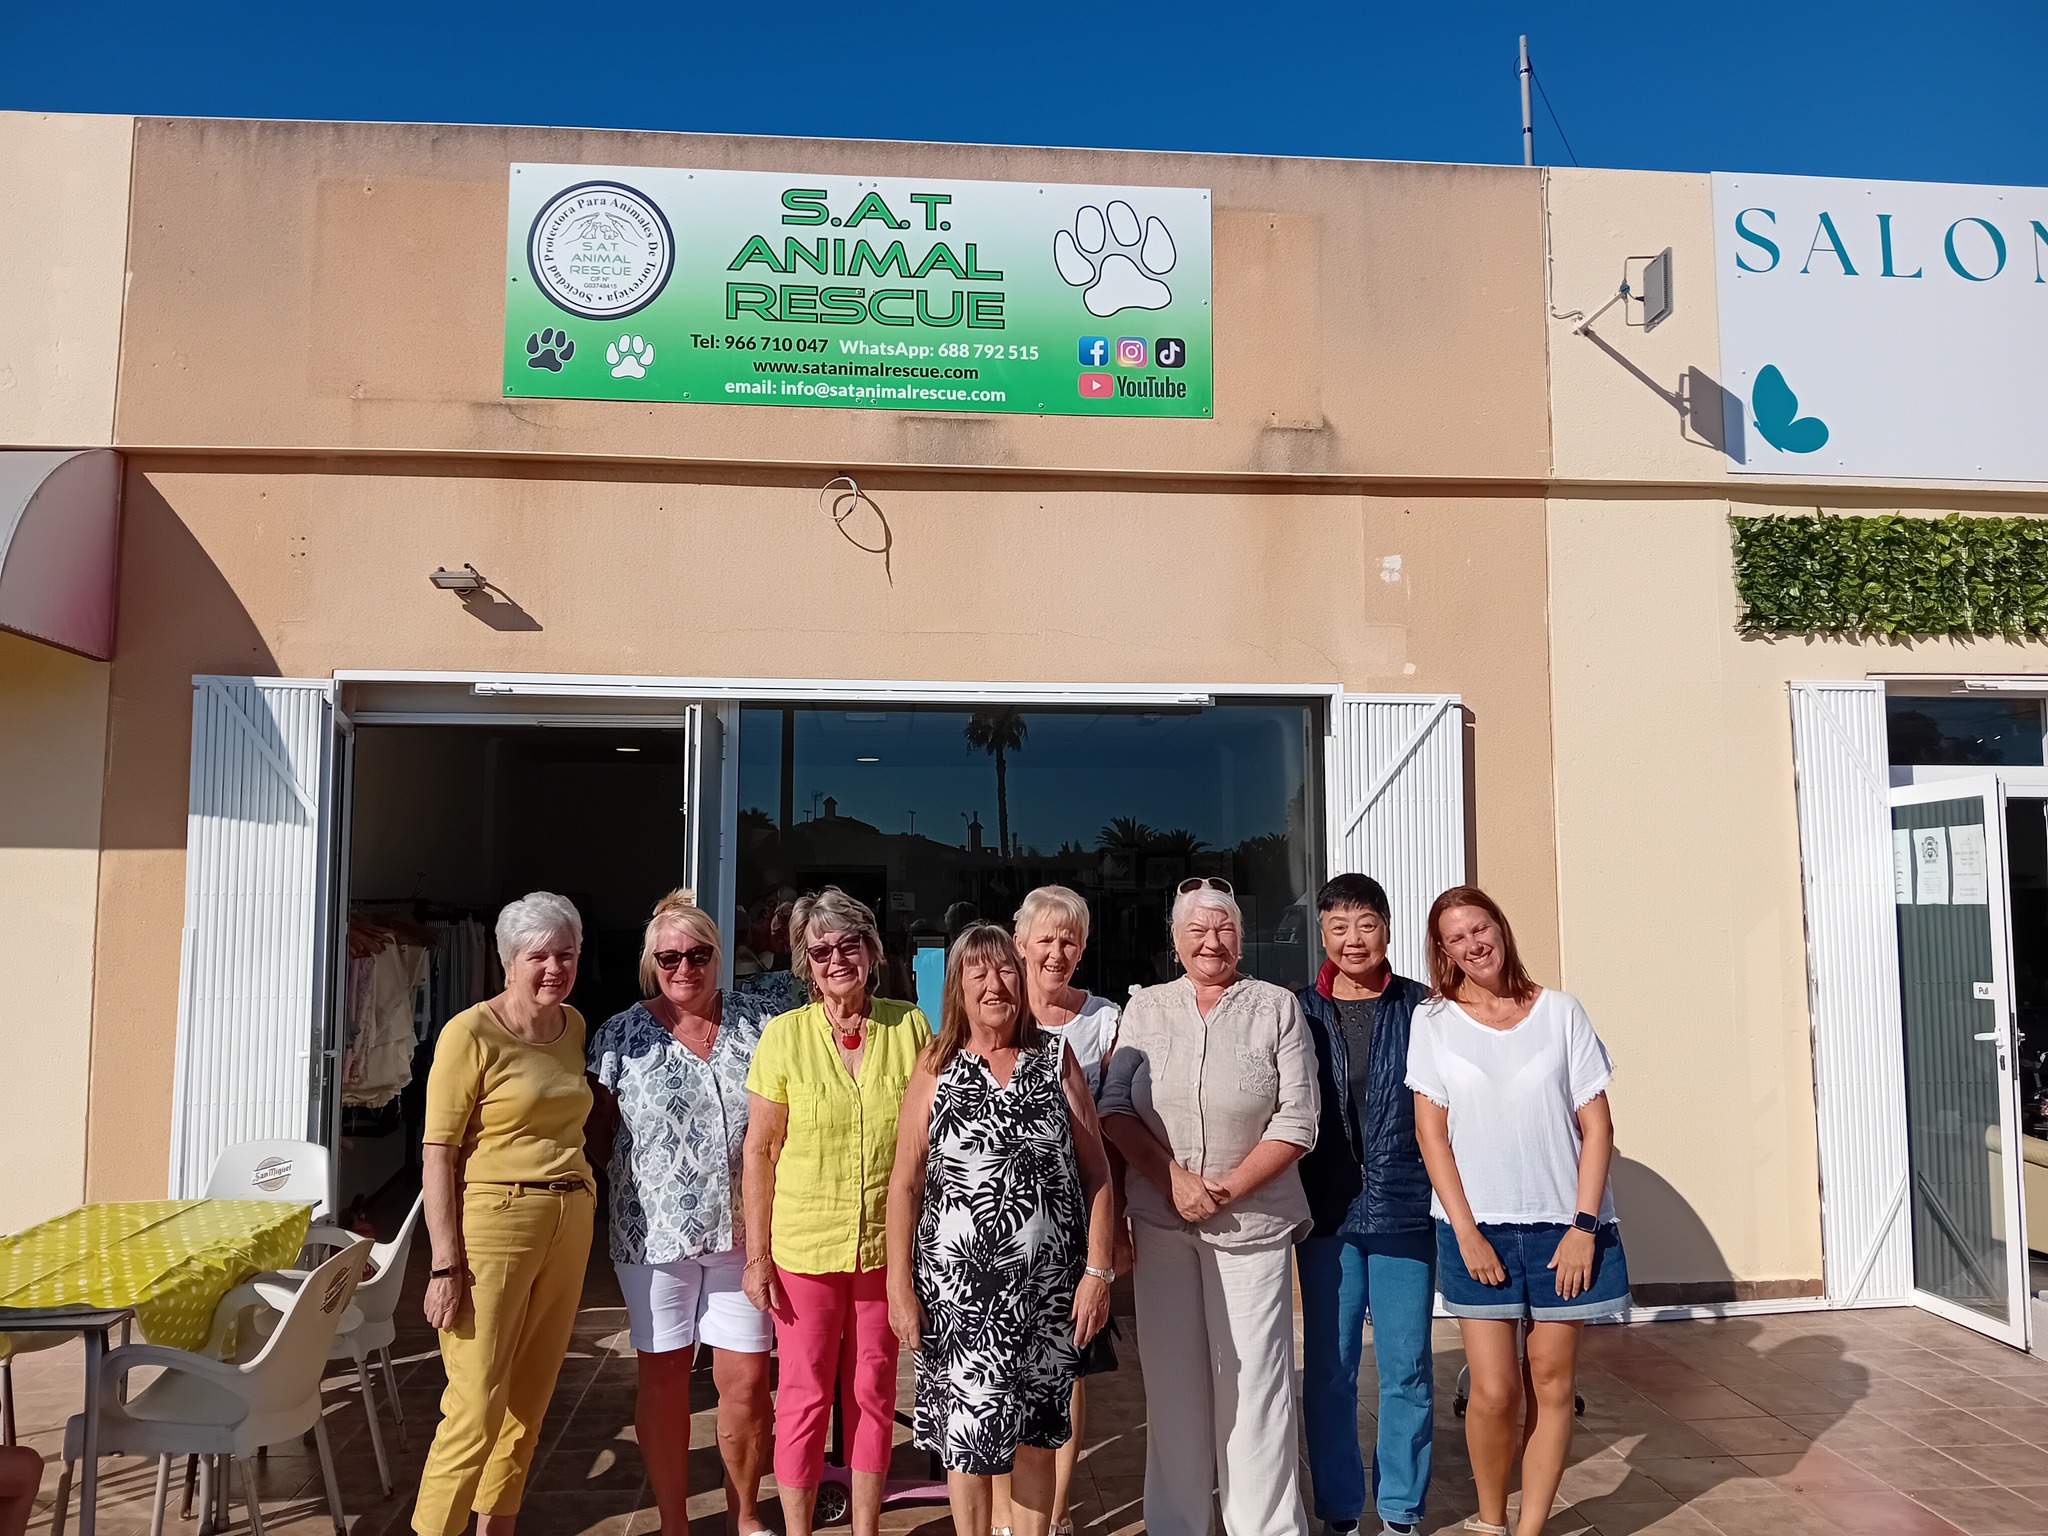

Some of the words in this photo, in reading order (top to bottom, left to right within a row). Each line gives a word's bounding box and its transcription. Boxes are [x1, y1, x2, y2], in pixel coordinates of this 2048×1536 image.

[577, 198, 607, 209] Para
[781, 188, 952, 231] S.A.T.
[609, 198, 654, 239] Animales
[544, 206, 576, 262] Protectora
[571, 253, 632, 264] ANIMAL
[648, 241, 659, 257] De
[726, 234, 1004, 281] ANIMAL
[569, 265, 632, 276] RESCUE
[606, 262, 657, 302] Torrevieja
[548, 264, 593, 303] Sociedad
[726, 281, 1006, 330] RESCUE
[690, 333, 720, 349] Tel:
[724, 335, 757, 350] 966
[760, 336, 793, 352] 710
[796, 338, 829, 353] 047
[839, 339, 935, 359] WhatsApp:
[938, 342, 970, 358] 688
[973, 343, 1005, 359] 792
[1008, 344, 1039, 360] 515
[753, 360, 979, 380] www.satanimalrescue.com
[724, 379, 777, 395] email:
[781, 380, 1006, 402] info@satanimalrescue.com
[1116, 375, 1187, 398] YouTube
